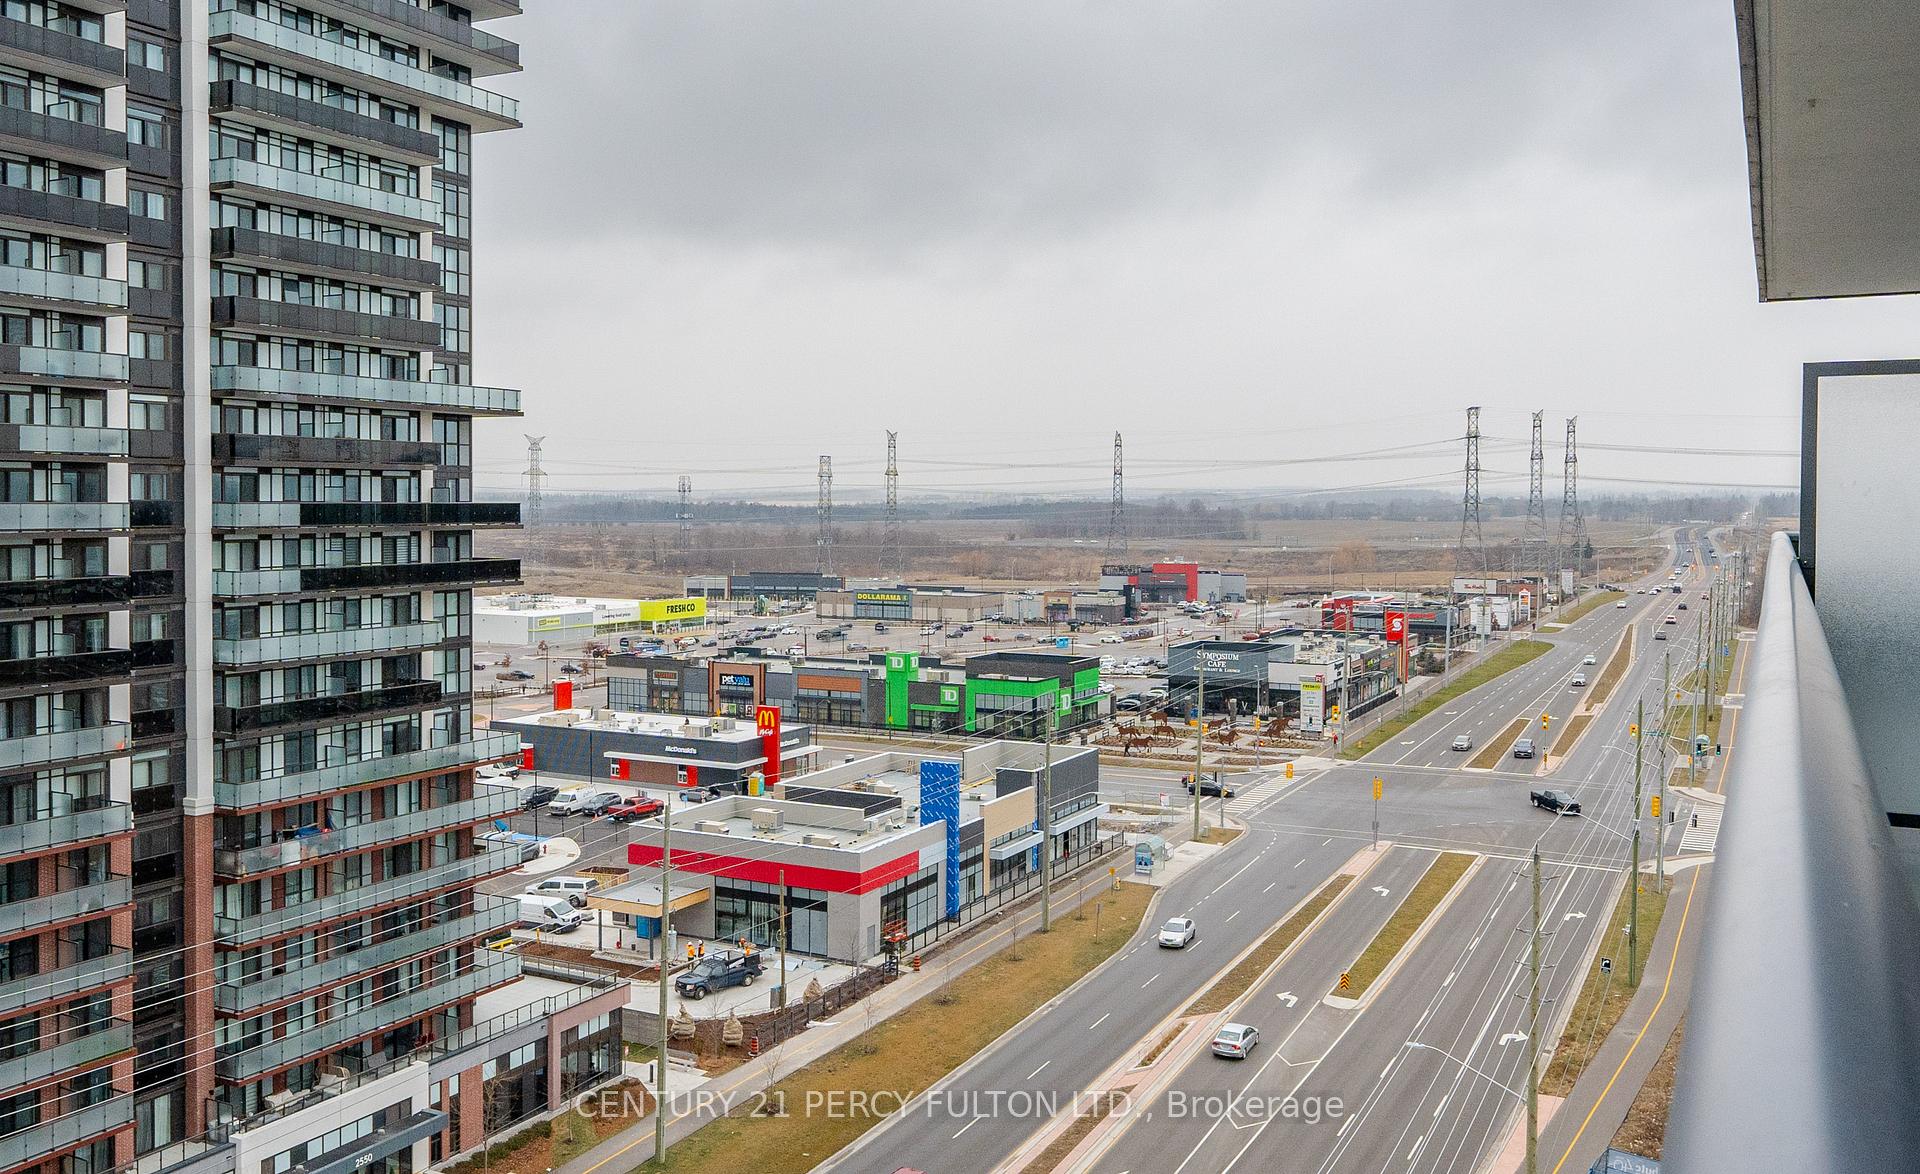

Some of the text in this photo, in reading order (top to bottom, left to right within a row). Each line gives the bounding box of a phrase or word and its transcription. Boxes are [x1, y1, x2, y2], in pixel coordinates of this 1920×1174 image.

[1196, 650, 1240, 660] SYMPOSIUM
[890, 656, 904, 668] TD
[910, 656, 918, 668] TD
[943, 689, 957, 702] TD
[1062, 694, 1071, 710] TD
[356, 1153, 372, 1168] 2550
